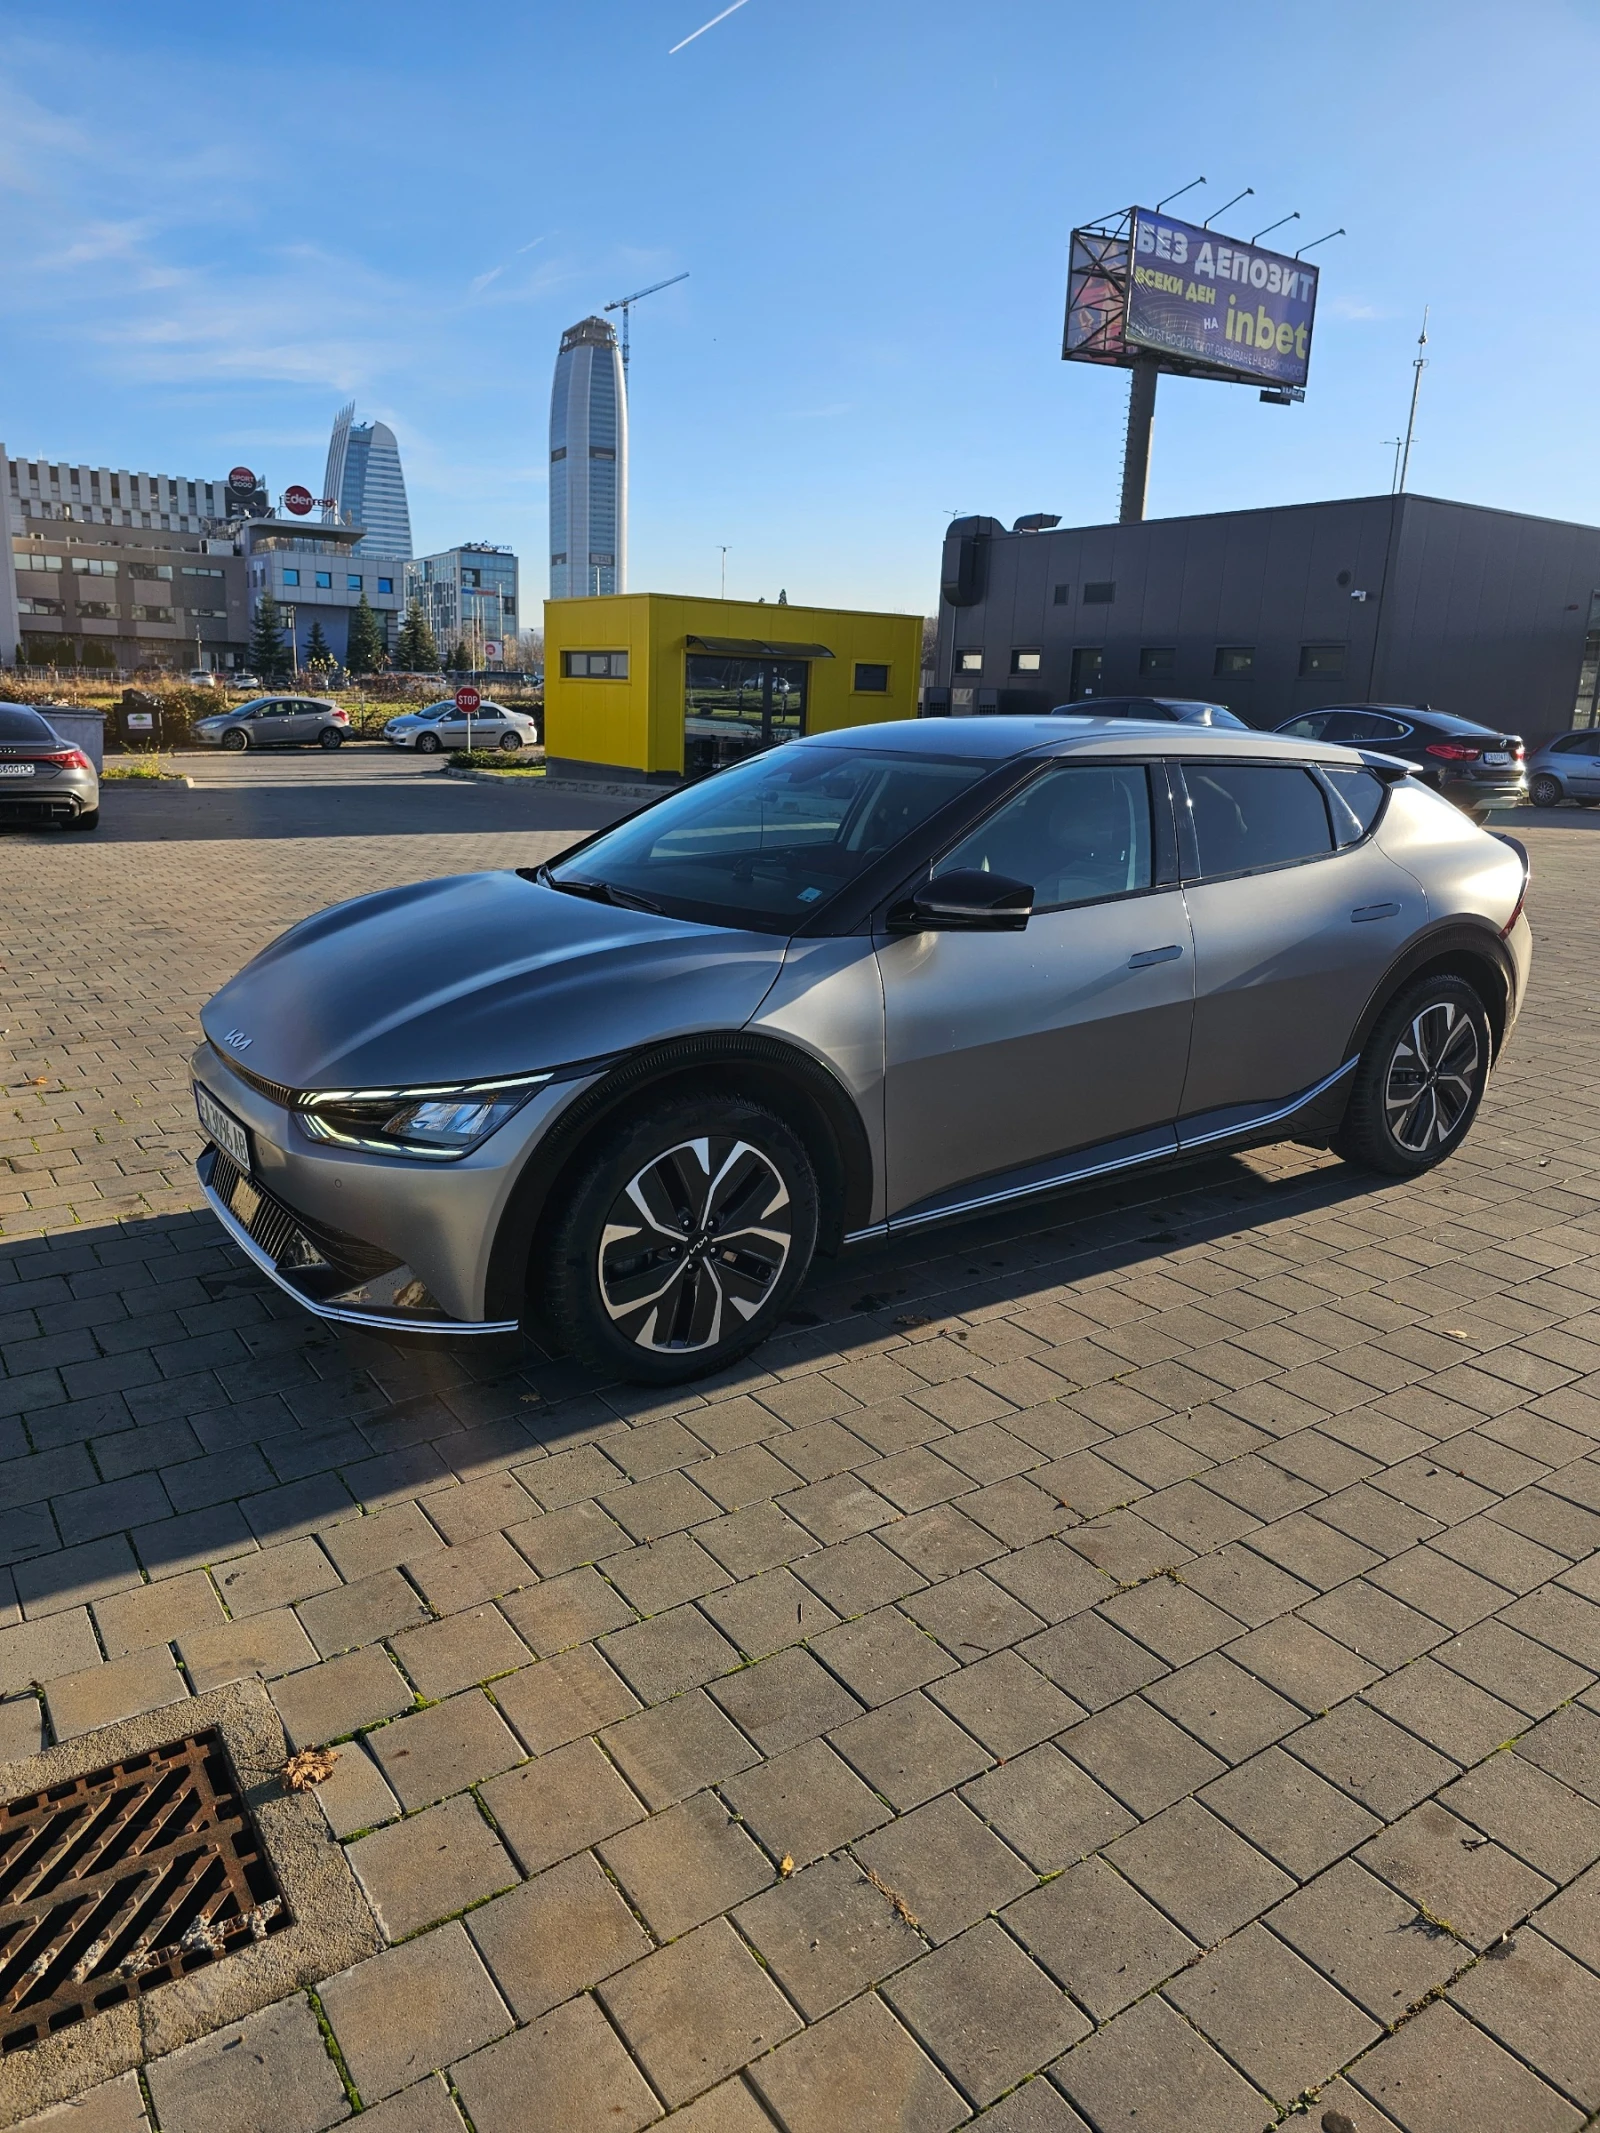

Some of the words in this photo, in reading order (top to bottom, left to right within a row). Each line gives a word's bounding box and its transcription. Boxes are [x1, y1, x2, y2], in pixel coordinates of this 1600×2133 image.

[1136, 220, 1189, 264] БЕЗ
[1194, 242, 1314, 302] ДЕПОЗИТ
[1135, 266, 1184, 296] ВСЕКИ
[1185, 282, 1216, 305] ДЕН
[1203, 317, 1219, 330] НА
[1225, 294, 1308, 360] inbet
[1166, 331, 1186, 348] НОСИ
[1186, 336, 1204, 352] РИСК
[1205, 342, 1214, 355] ОТ
[231, 474, 254, 483] SPORT
[233, 481, 253, 489] 2000
[284, 493, 335, 508] Edenred
[458, 695, 478, 705] STOP
